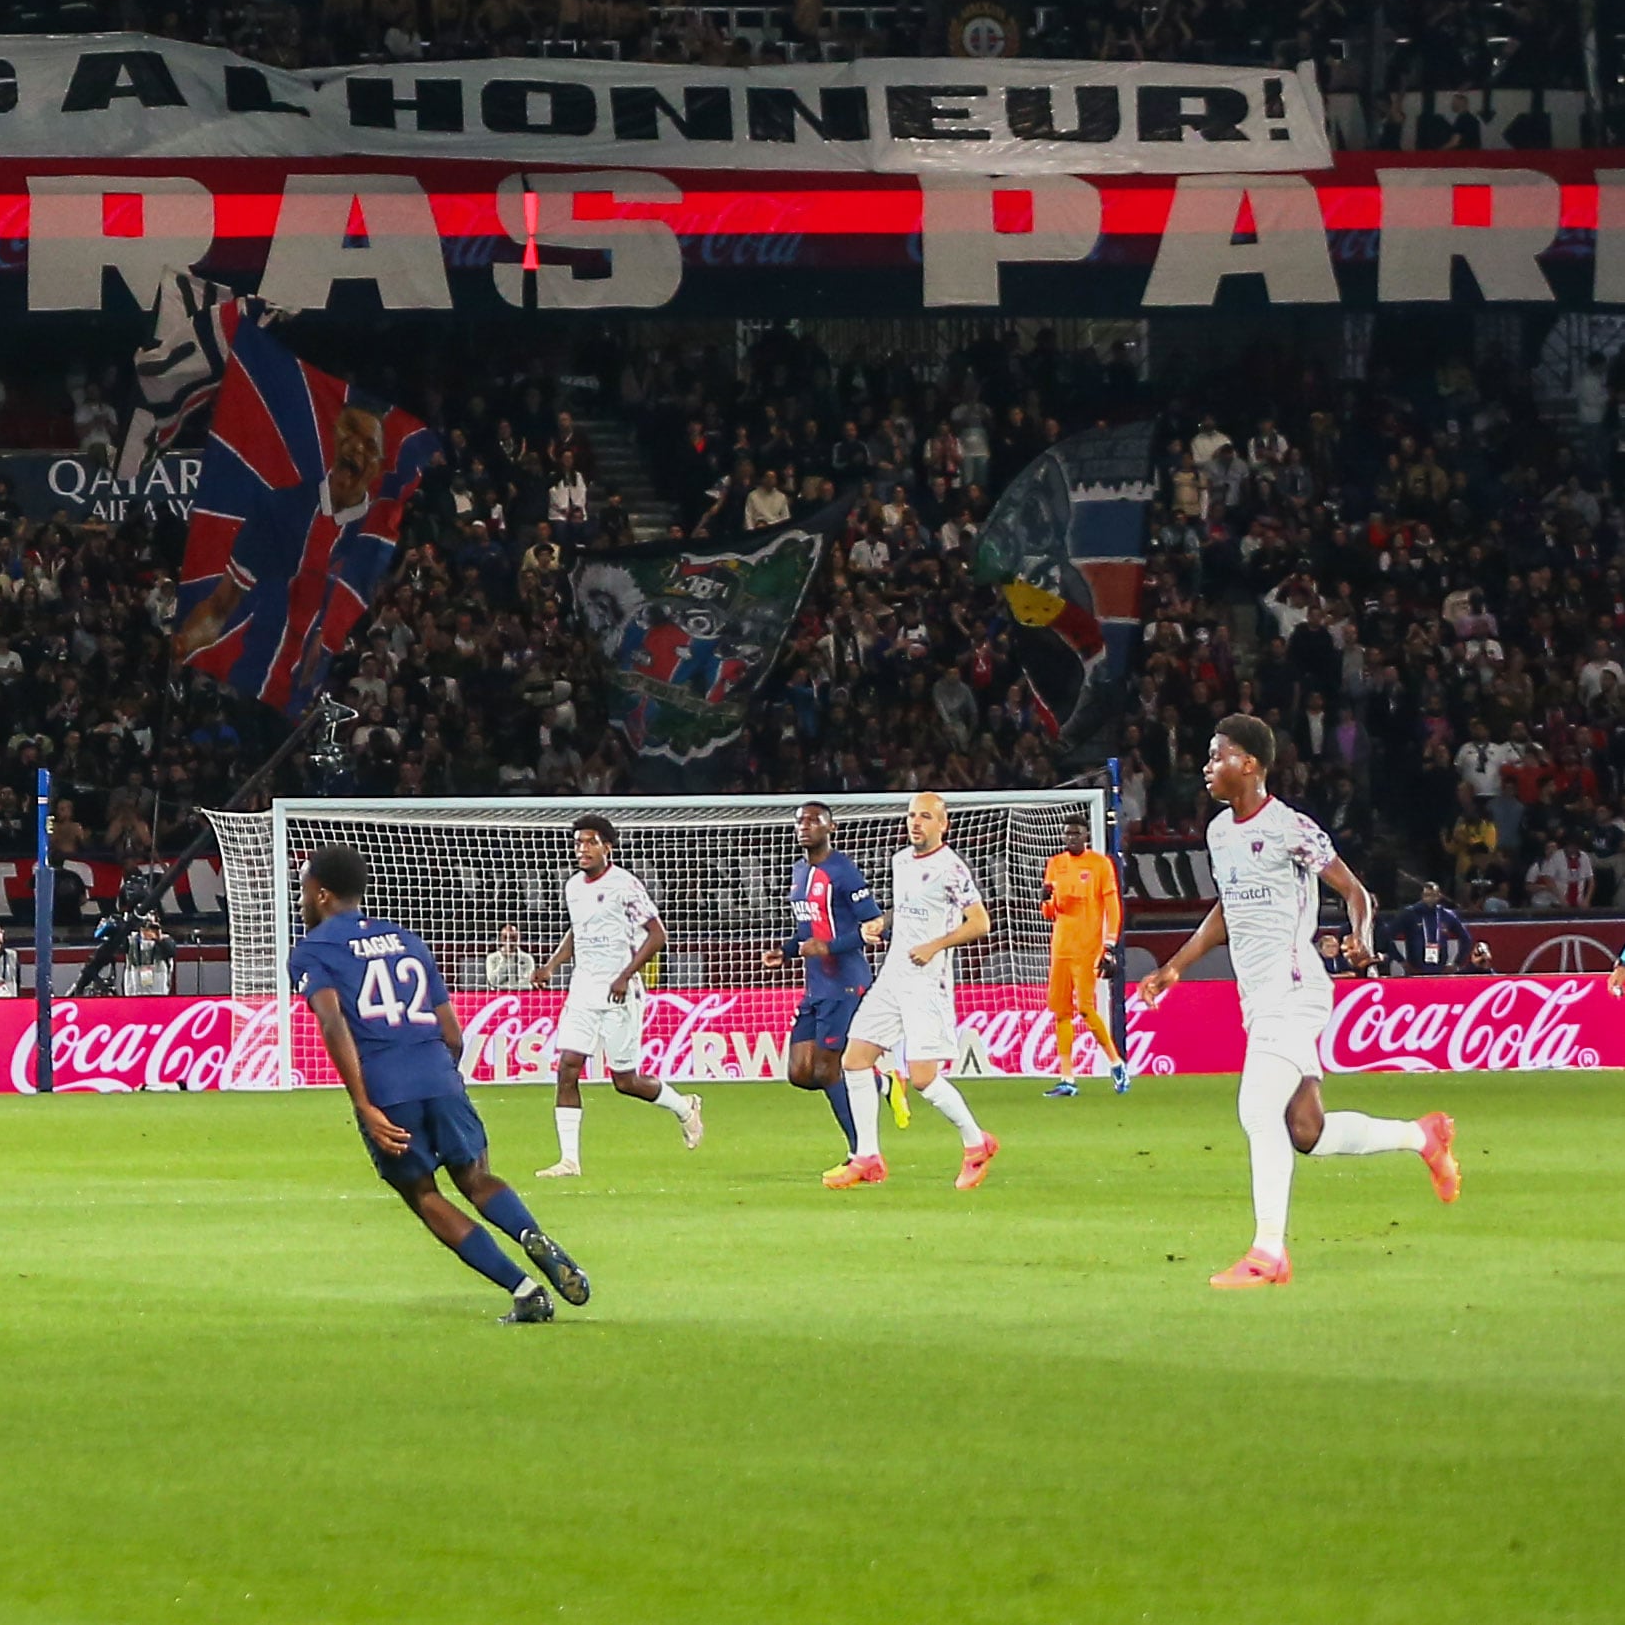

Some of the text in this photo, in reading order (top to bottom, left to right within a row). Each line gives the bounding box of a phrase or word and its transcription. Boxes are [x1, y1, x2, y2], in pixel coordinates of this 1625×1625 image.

[60, 50, 189, 112] A
[348, 933, 407, 958] ZAGUE
[357, 956, 438, 1028] 42
